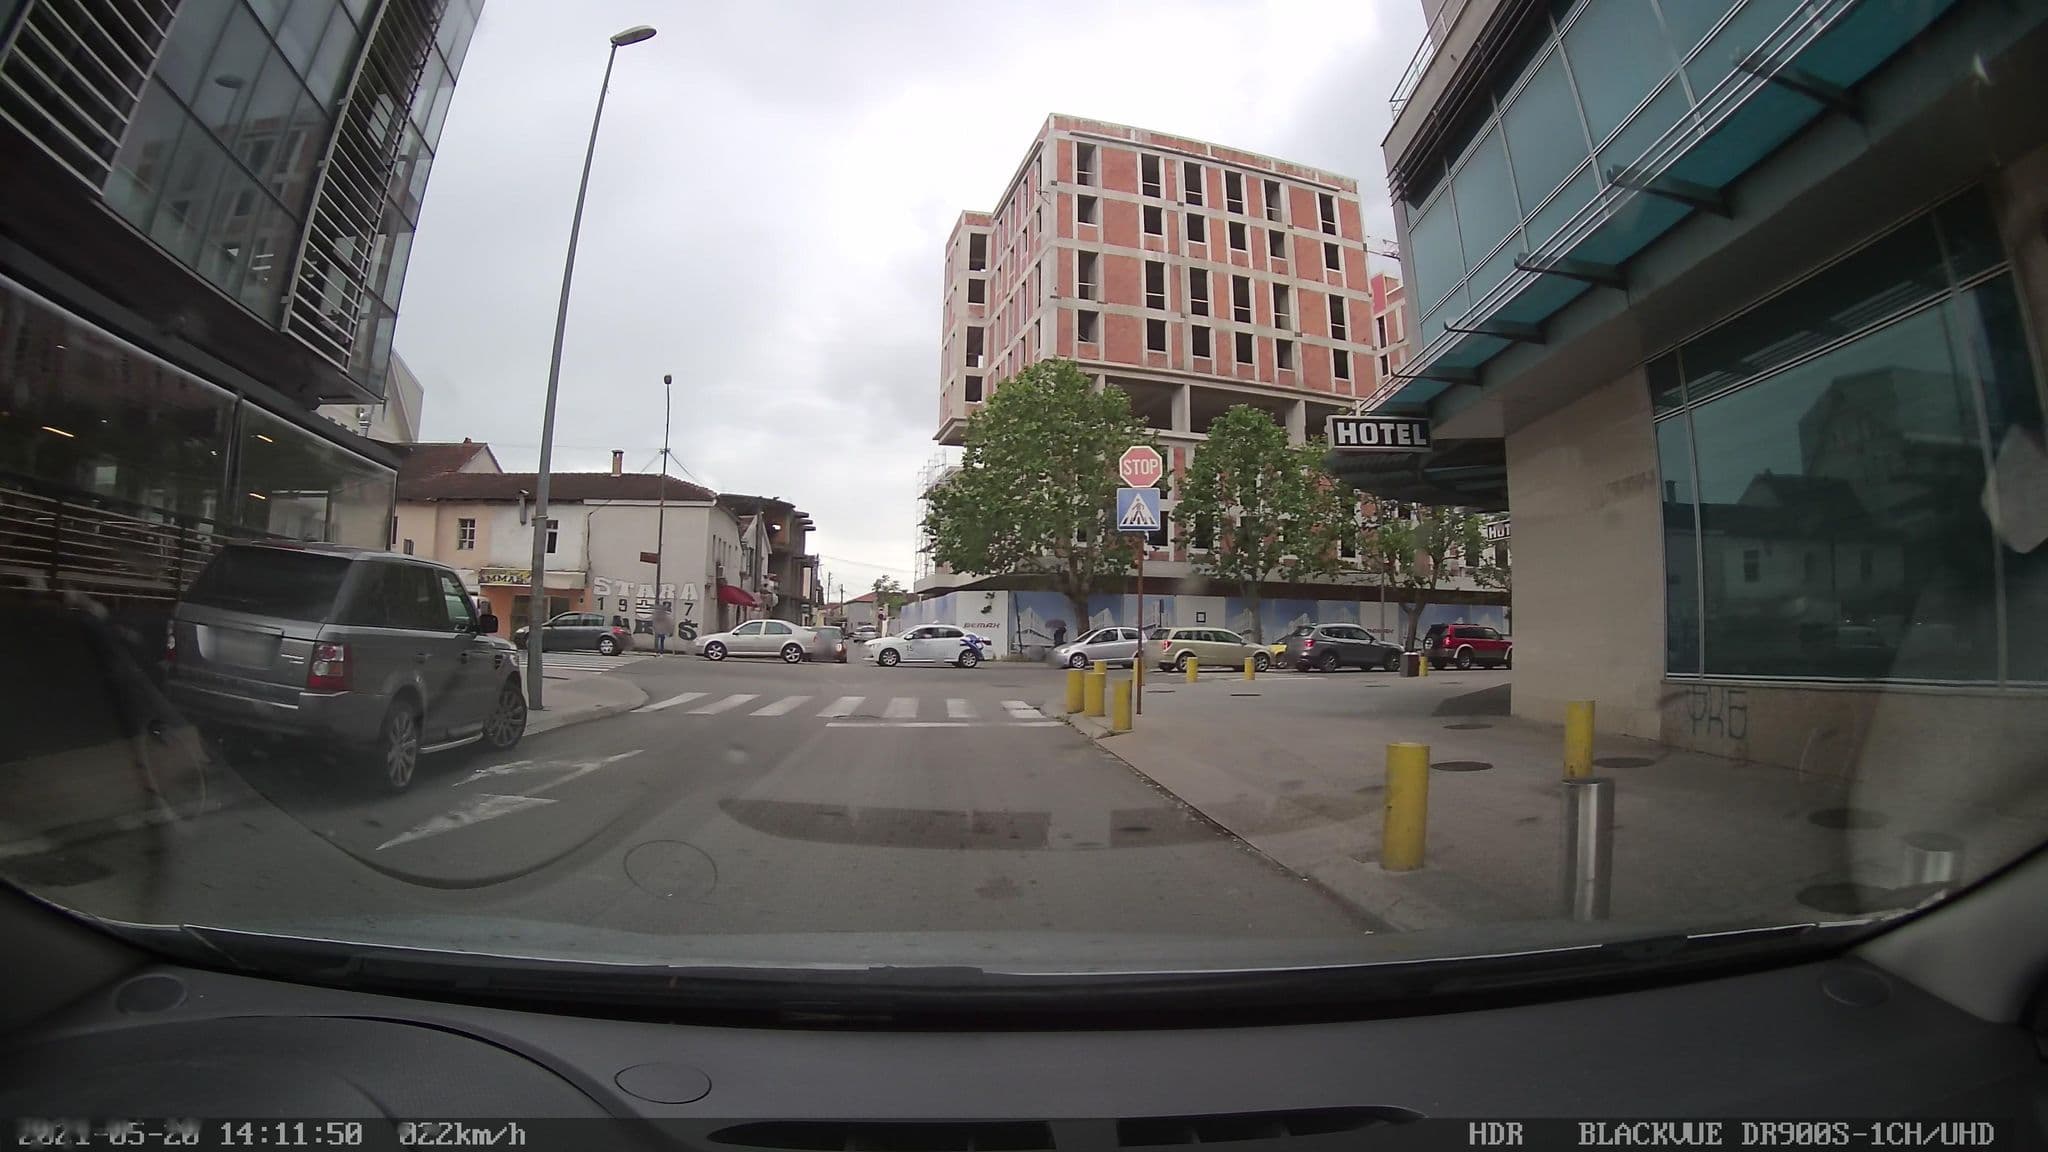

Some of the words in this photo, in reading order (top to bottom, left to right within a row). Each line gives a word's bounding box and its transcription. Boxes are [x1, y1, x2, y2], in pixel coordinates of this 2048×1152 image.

[1336, 422, 1427, 446] HOTEL
[1123, 458, 1159, 476] STOP
[593, 576, 699, 601] STARA
